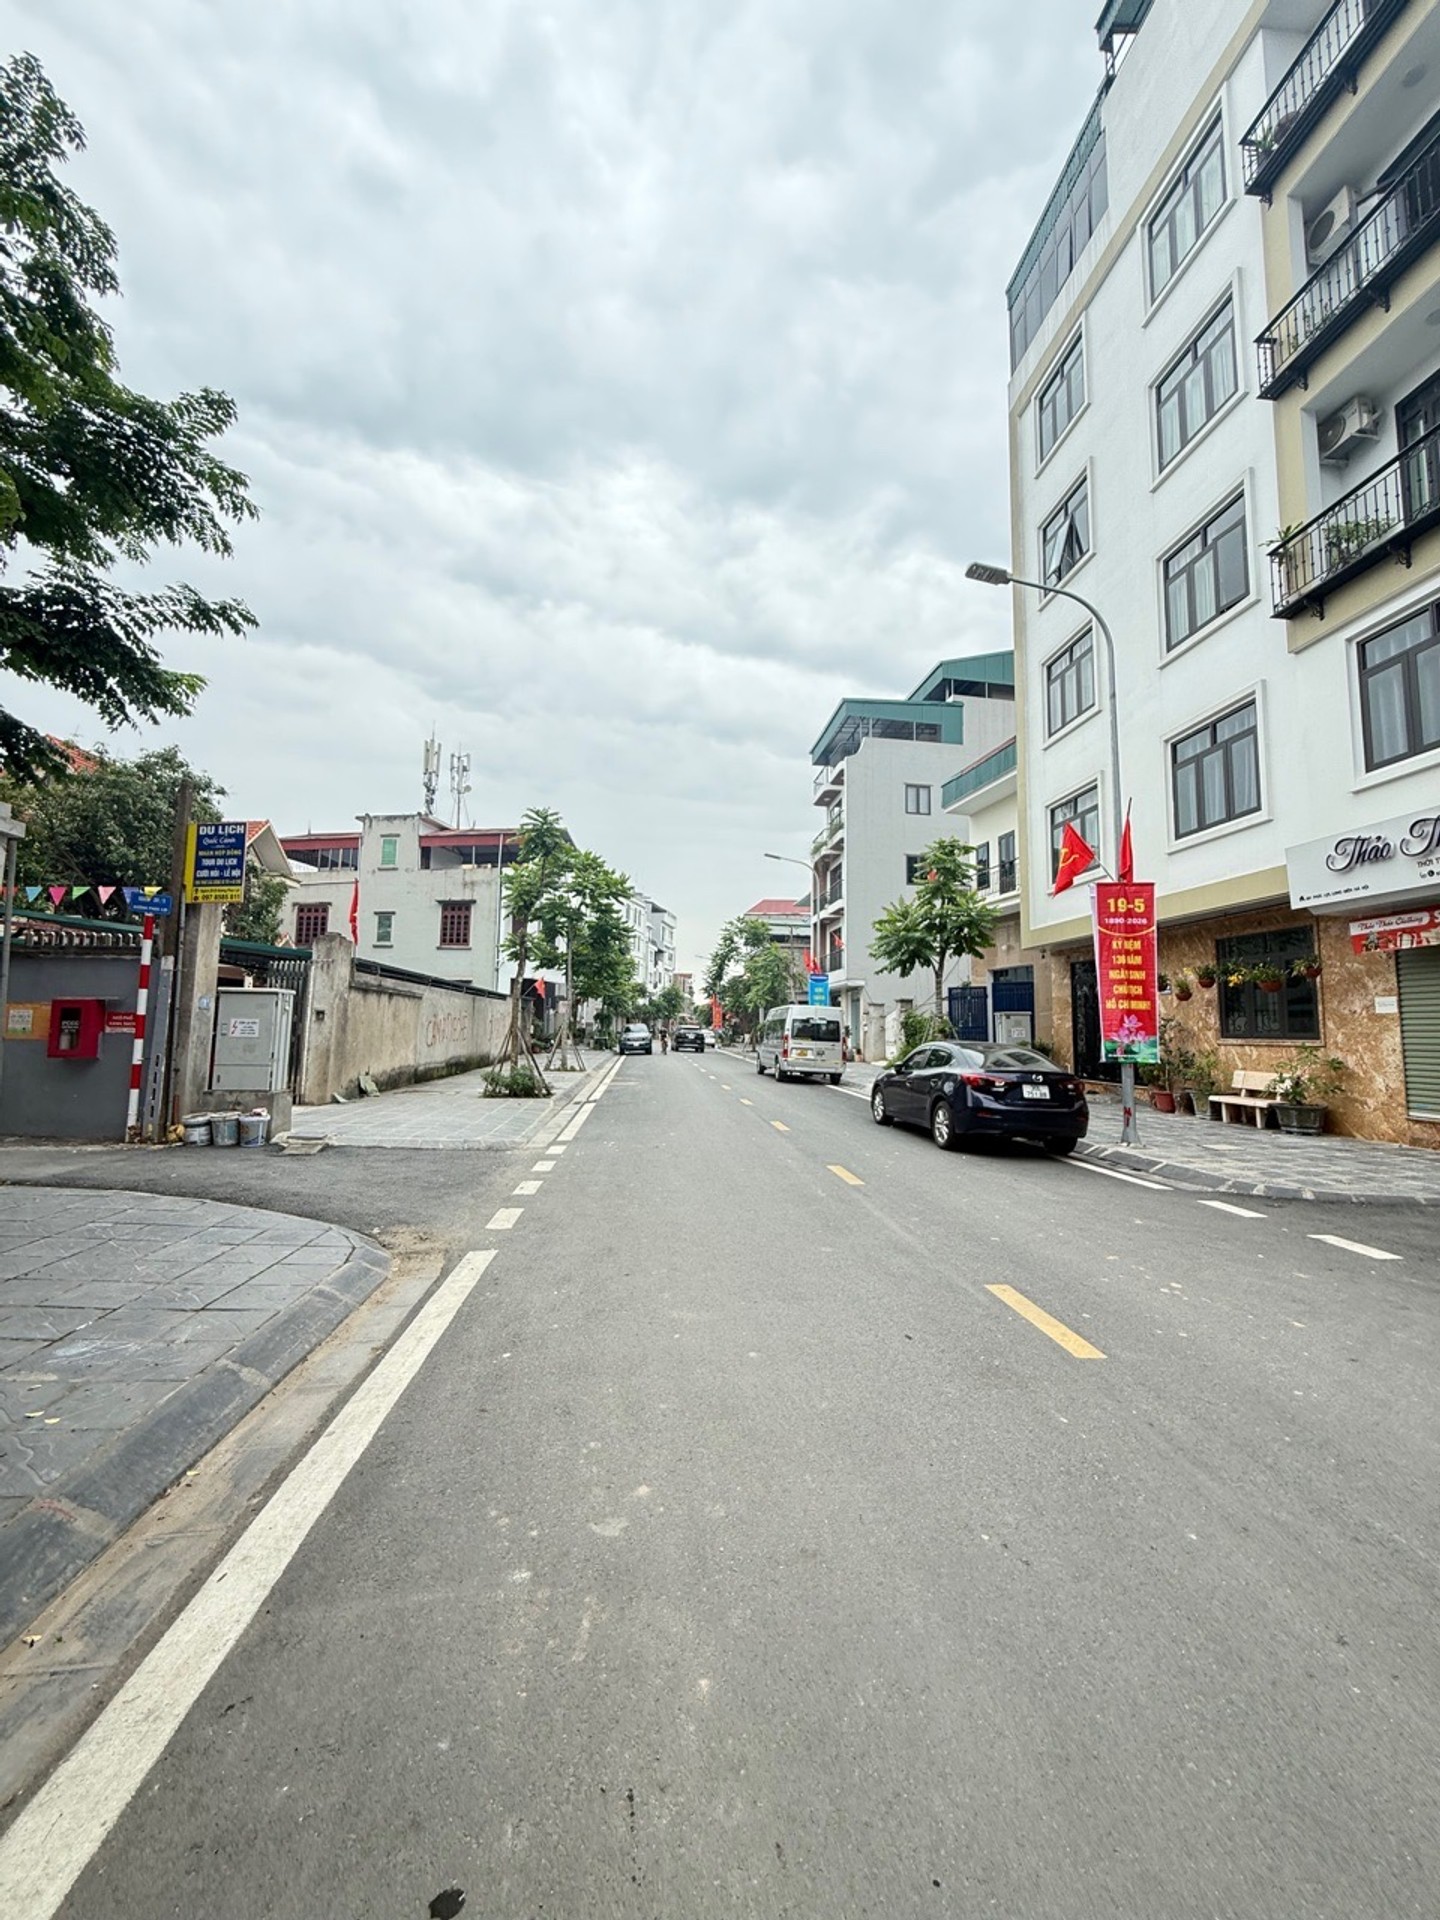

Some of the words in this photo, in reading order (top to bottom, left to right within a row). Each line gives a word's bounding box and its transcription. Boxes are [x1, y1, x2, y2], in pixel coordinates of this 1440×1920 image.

[199, 826, 215, 835] DU
[218, 825, 244, 836] LỊCH
[1326, 835, 1392, 873] Thảo
[202, 858, 216, 866] TOUR
[216, 858, 224, 866] DU
[225, 858, 238, 866] LỊCH
[1107, 898, 1145, 913] 19-5
[1112, 937, 1122, 950] KỶ
[1105, 996, 1117, 1009] HỒ
